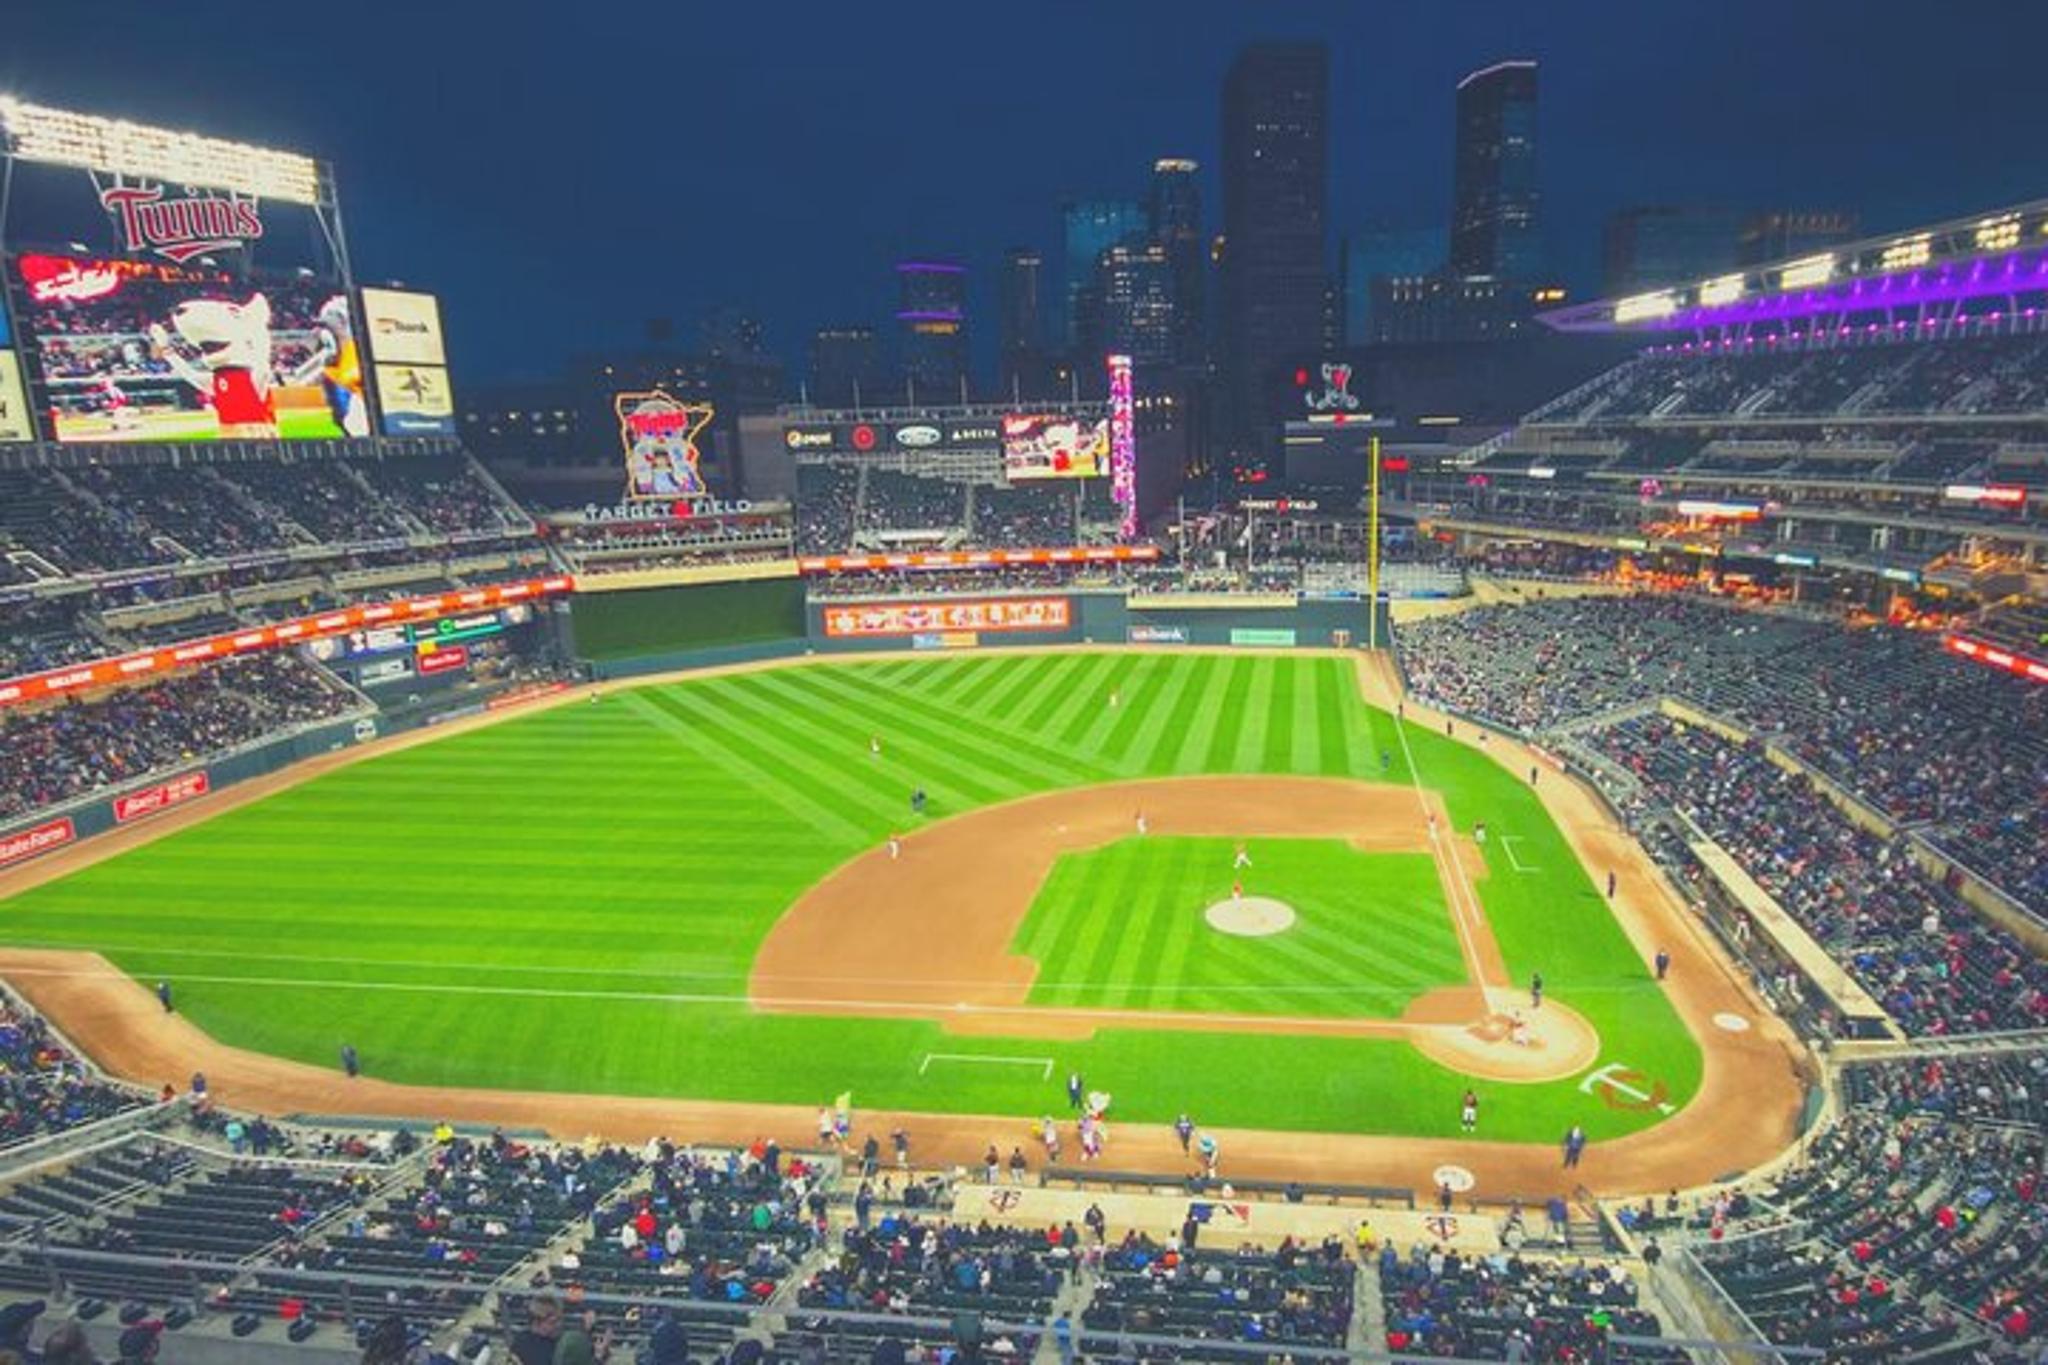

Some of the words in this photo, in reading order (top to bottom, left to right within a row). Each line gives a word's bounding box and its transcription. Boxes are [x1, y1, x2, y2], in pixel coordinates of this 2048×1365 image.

[101, 183, 263, 251] Twins
[585, 503, 671, 522] TARGET
[693, 499, 752, 518] FIELD
